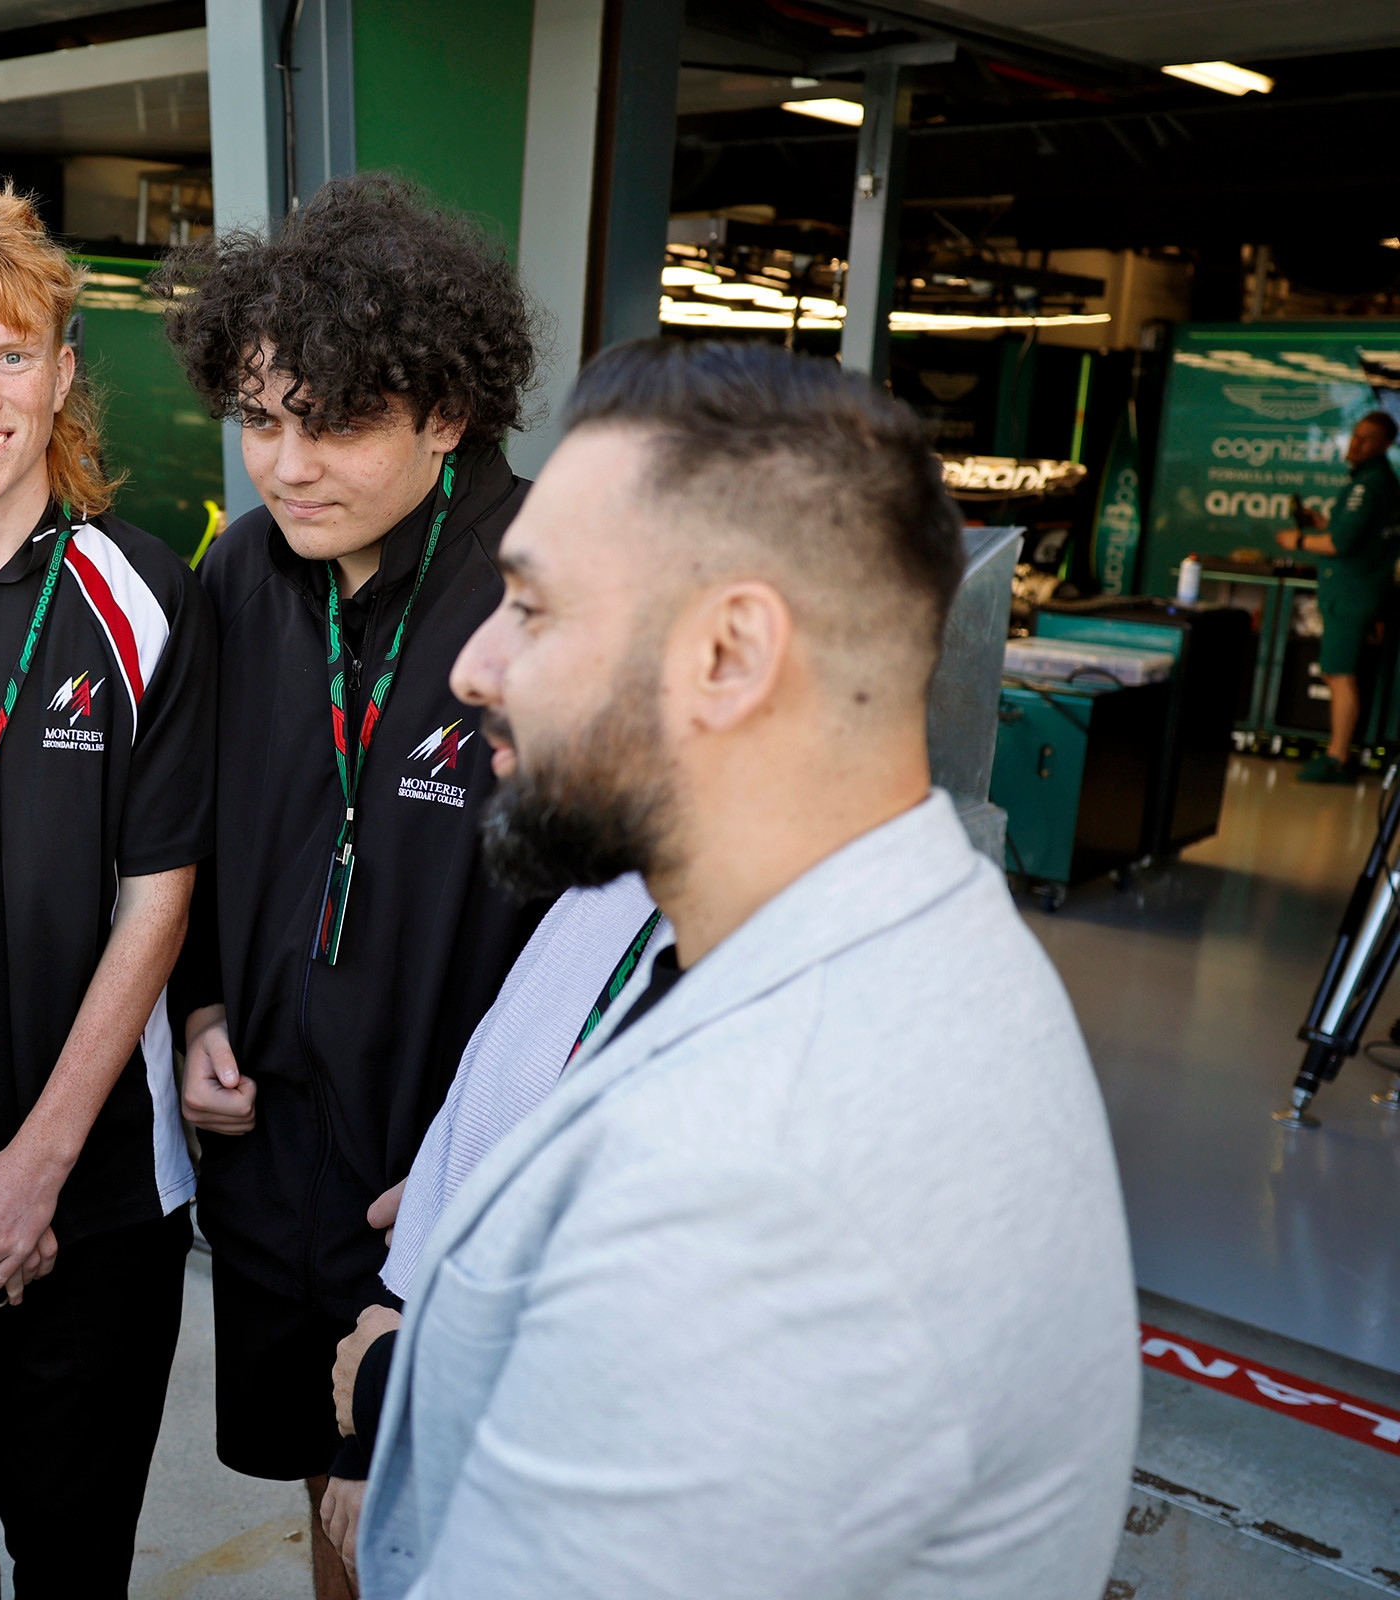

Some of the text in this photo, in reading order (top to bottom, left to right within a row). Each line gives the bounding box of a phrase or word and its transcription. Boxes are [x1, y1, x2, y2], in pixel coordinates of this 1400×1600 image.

[31, 570, 58, 629] PADDOCK
[49, 540, 66, 571] 2023
[42, 740, 79, 750] SECONDARY
[44, 727, 104, 742] MONTEREY
[398, 787, 466, 808] SECONDARY COLLEGE
[399, 776, 467, 798] MONTEREY
